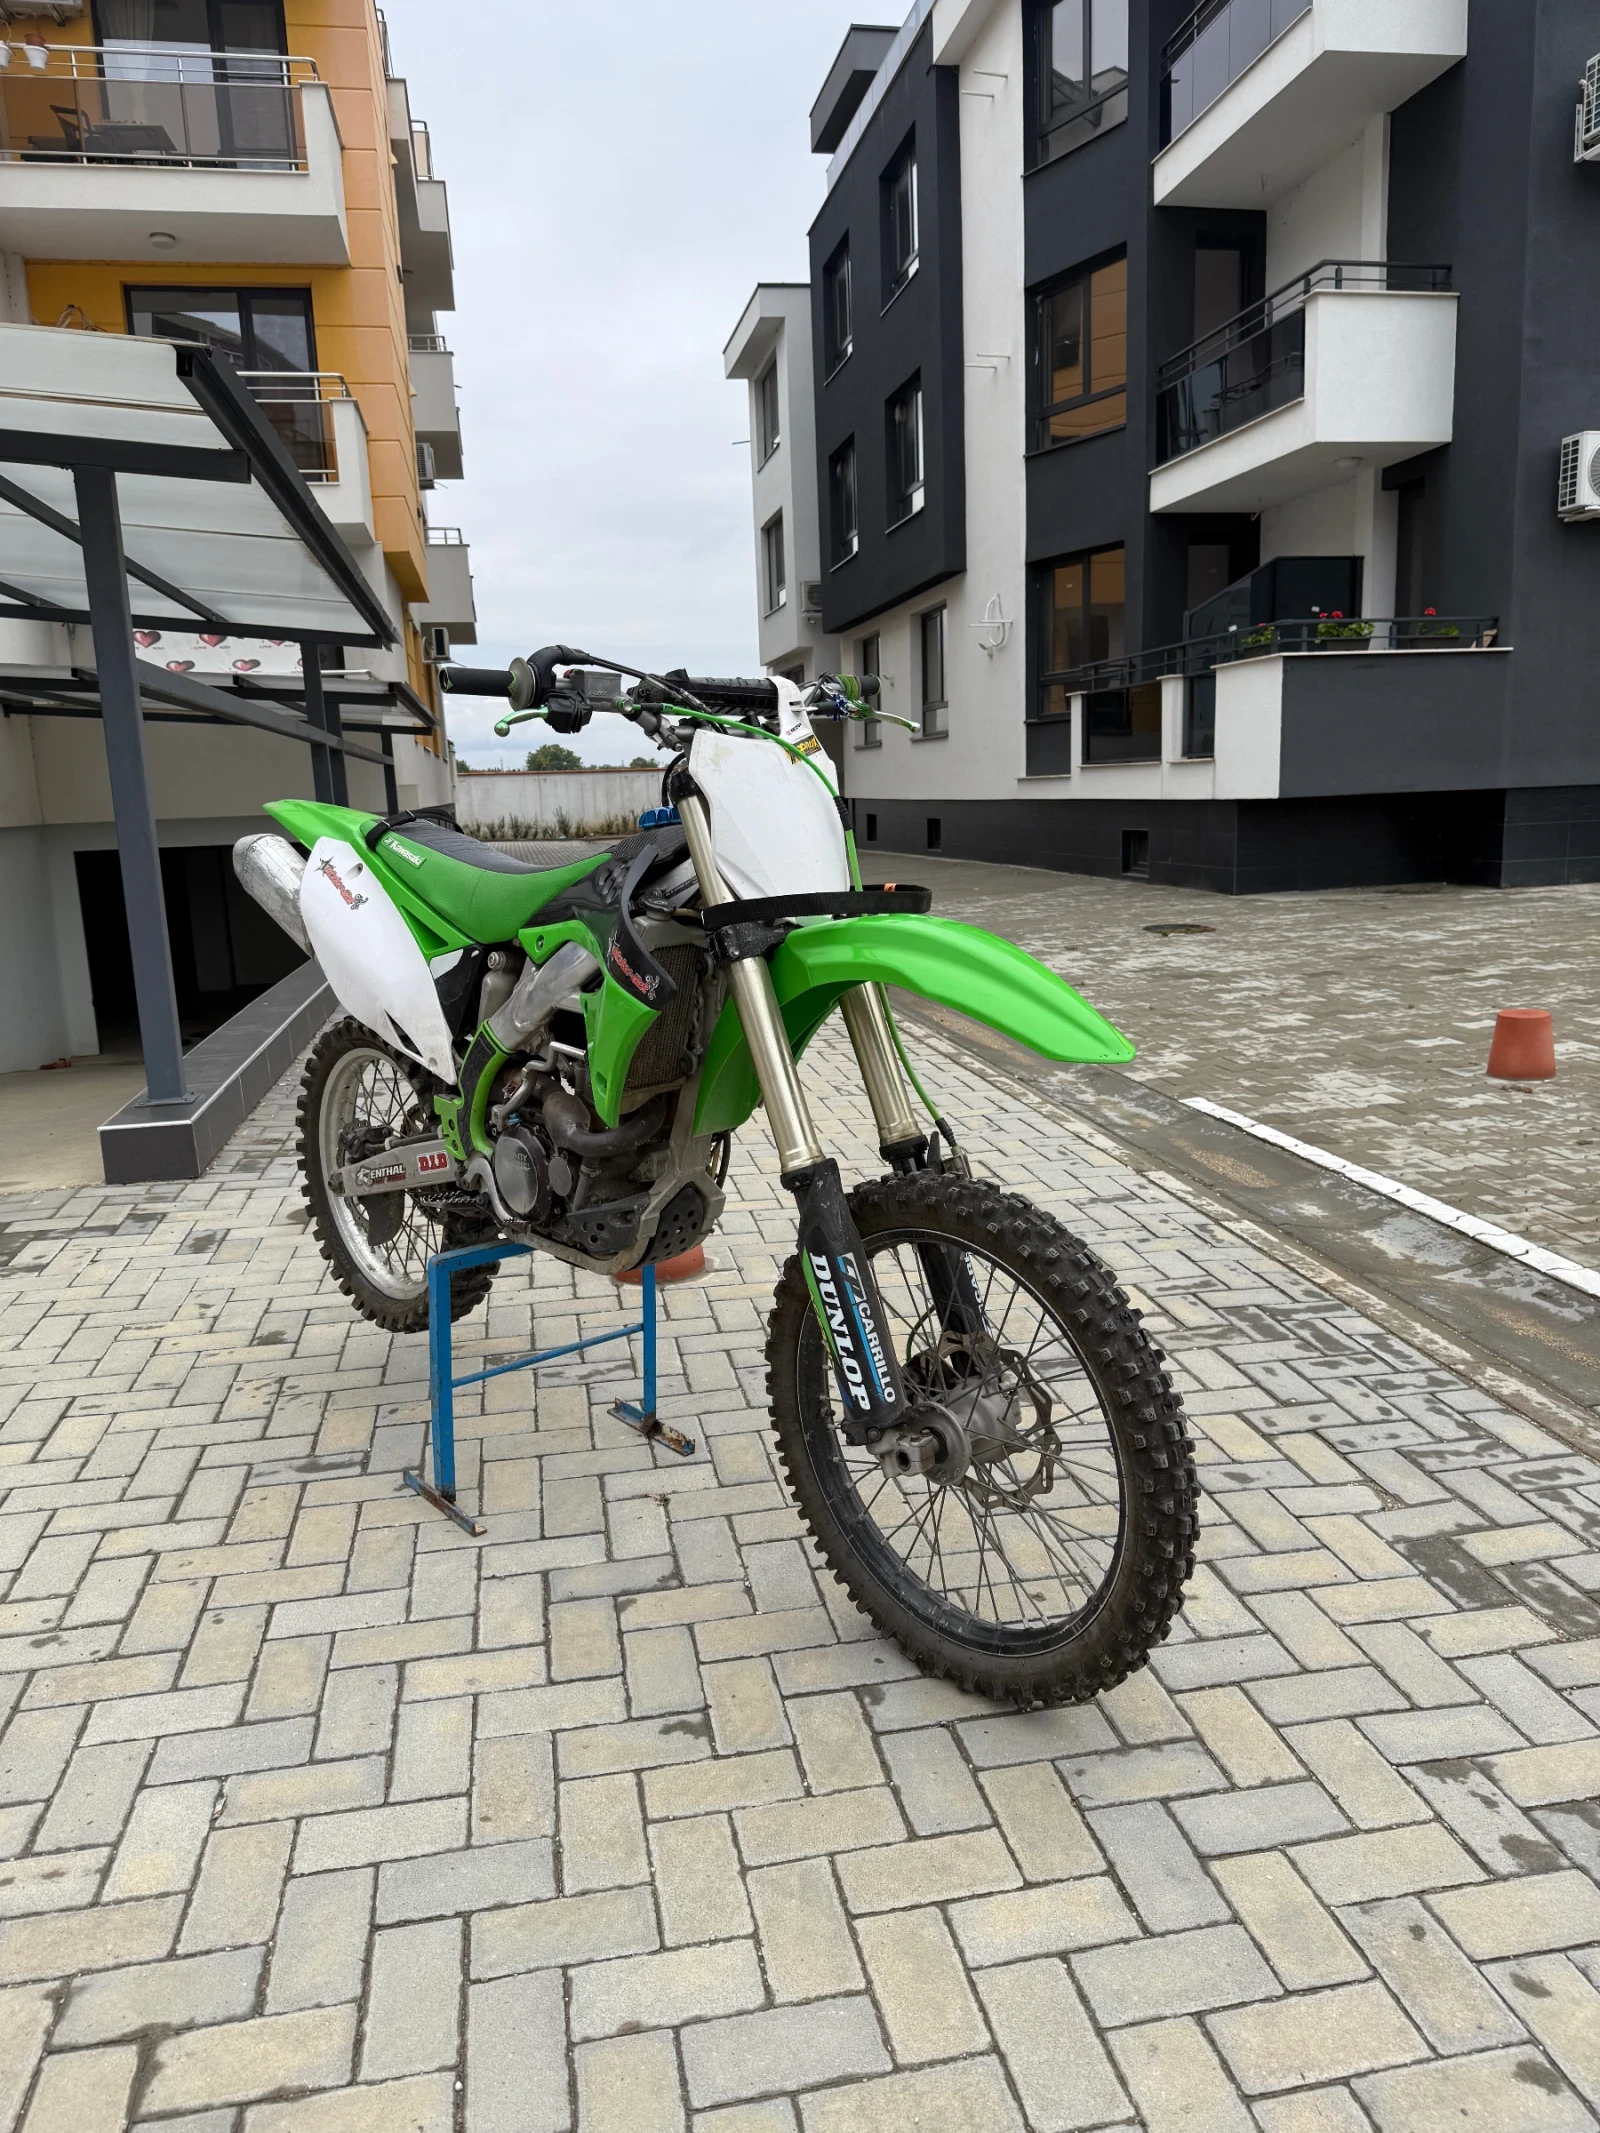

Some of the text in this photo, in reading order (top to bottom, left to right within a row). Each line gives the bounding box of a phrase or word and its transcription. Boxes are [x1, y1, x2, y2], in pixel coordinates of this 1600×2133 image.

[390, 840, 424, 866] Kawasaki
[810, 1252, 871, 1411] DUNLOP
[858, 1302, 896, 1403] CARRILLO
